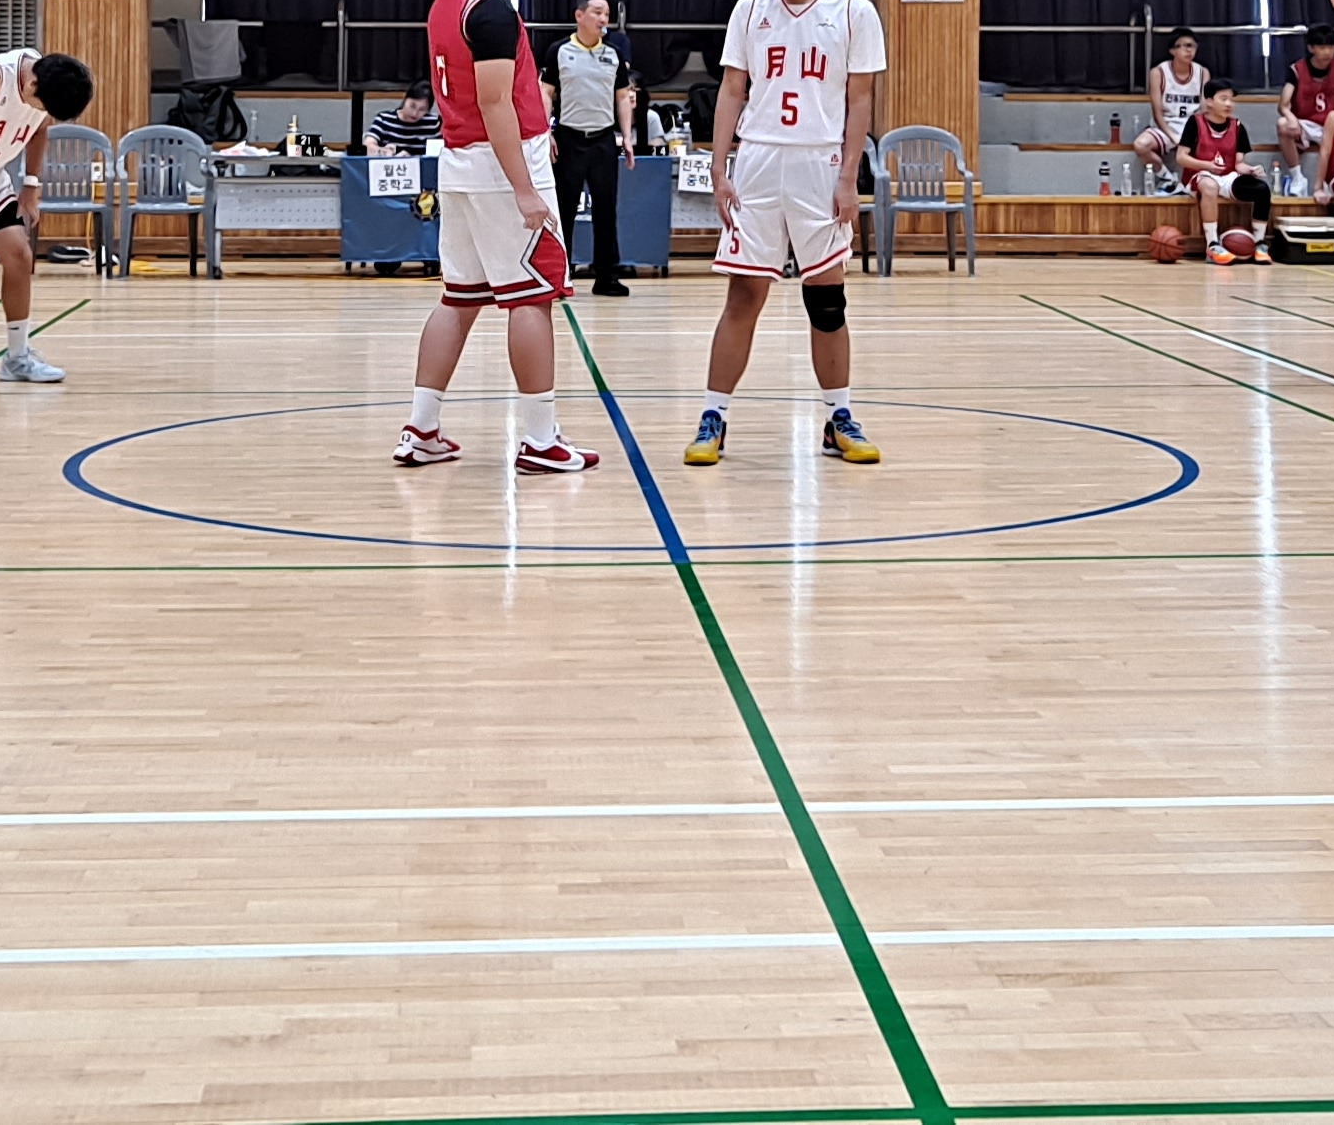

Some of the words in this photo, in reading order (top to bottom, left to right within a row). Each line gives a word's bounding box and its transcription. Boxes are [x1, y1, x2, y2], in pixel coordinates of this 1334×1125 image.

[766, 45, 827, 81] 月山
[781, 91, 799, 126] 5
[383, 164, 407, 176] 월산
[378, 179, 414, 192] 중학교
[687, 174, 714, 188] 중학
[729, 226, 740, 255] 5
